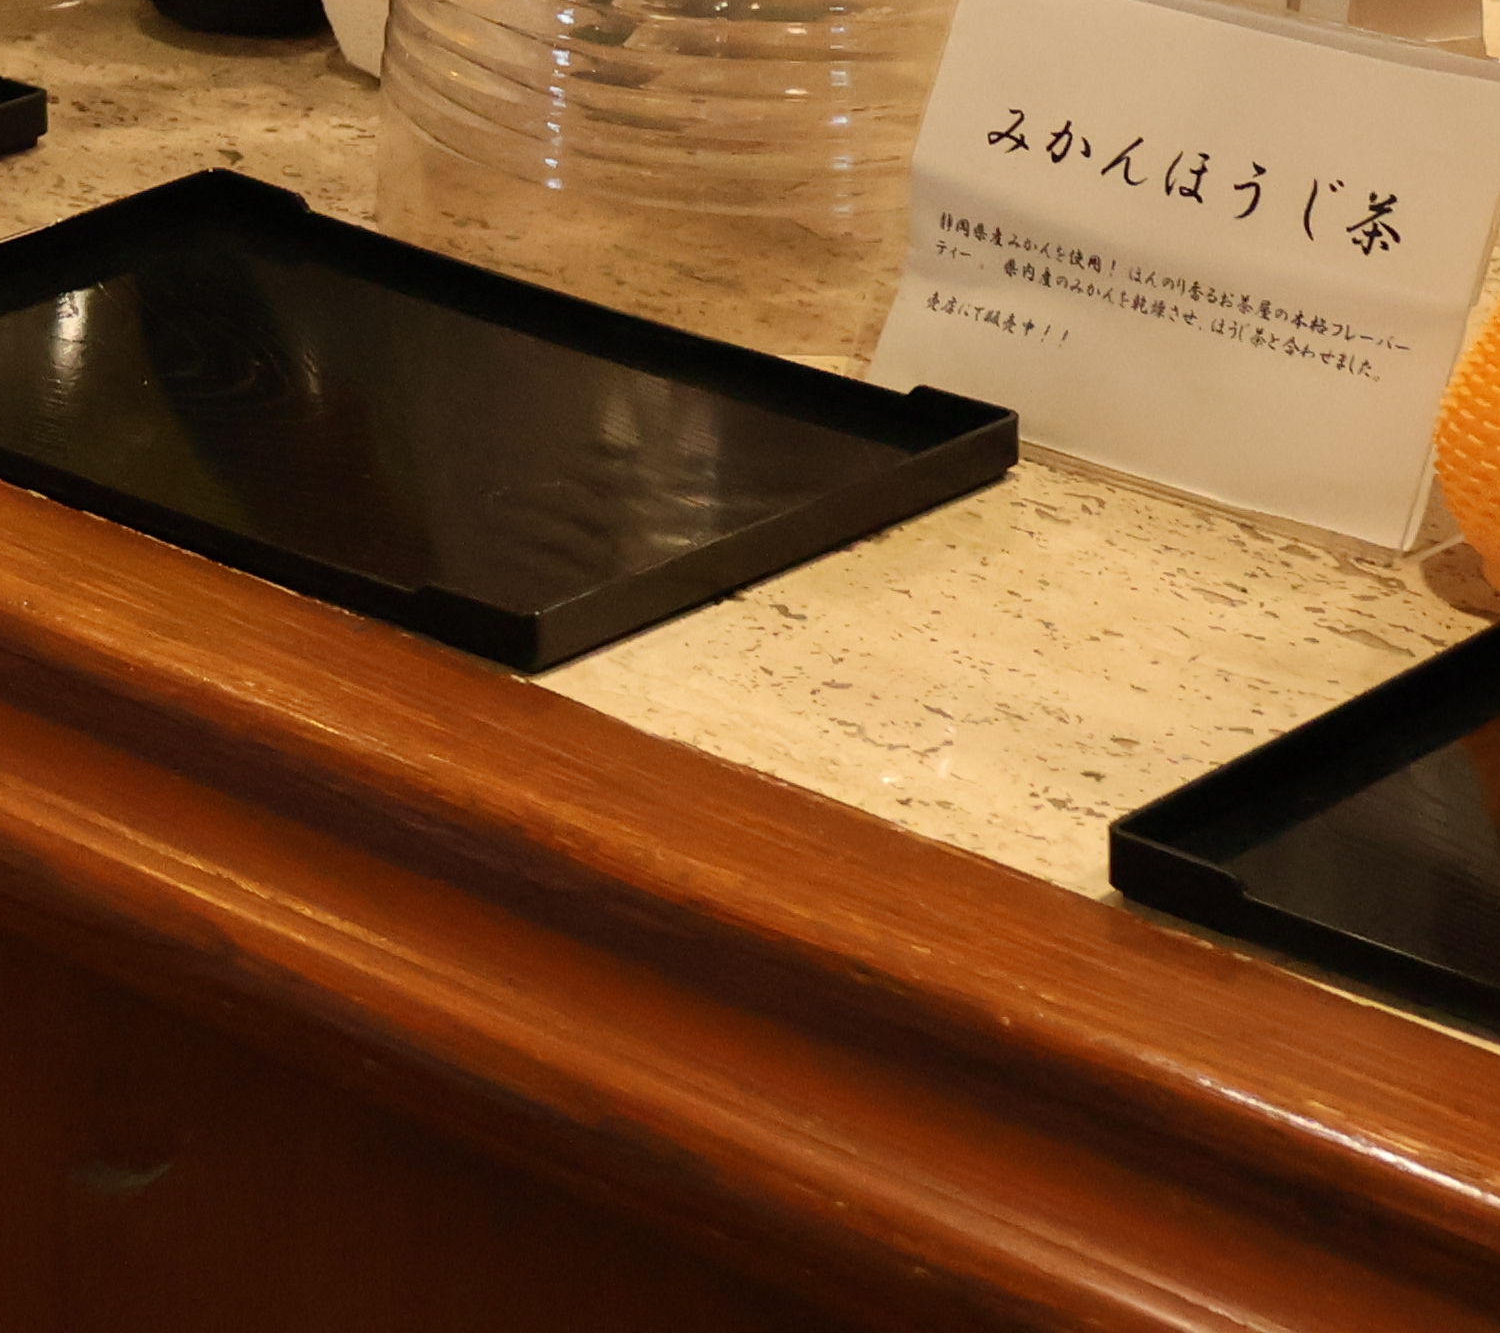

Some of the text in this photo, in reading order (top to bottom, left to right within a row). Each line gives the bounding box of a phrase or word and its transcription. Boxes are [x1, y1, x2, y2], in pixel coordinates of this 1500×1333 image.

[987, 107, 1401, 256] みかんほうじ茶
